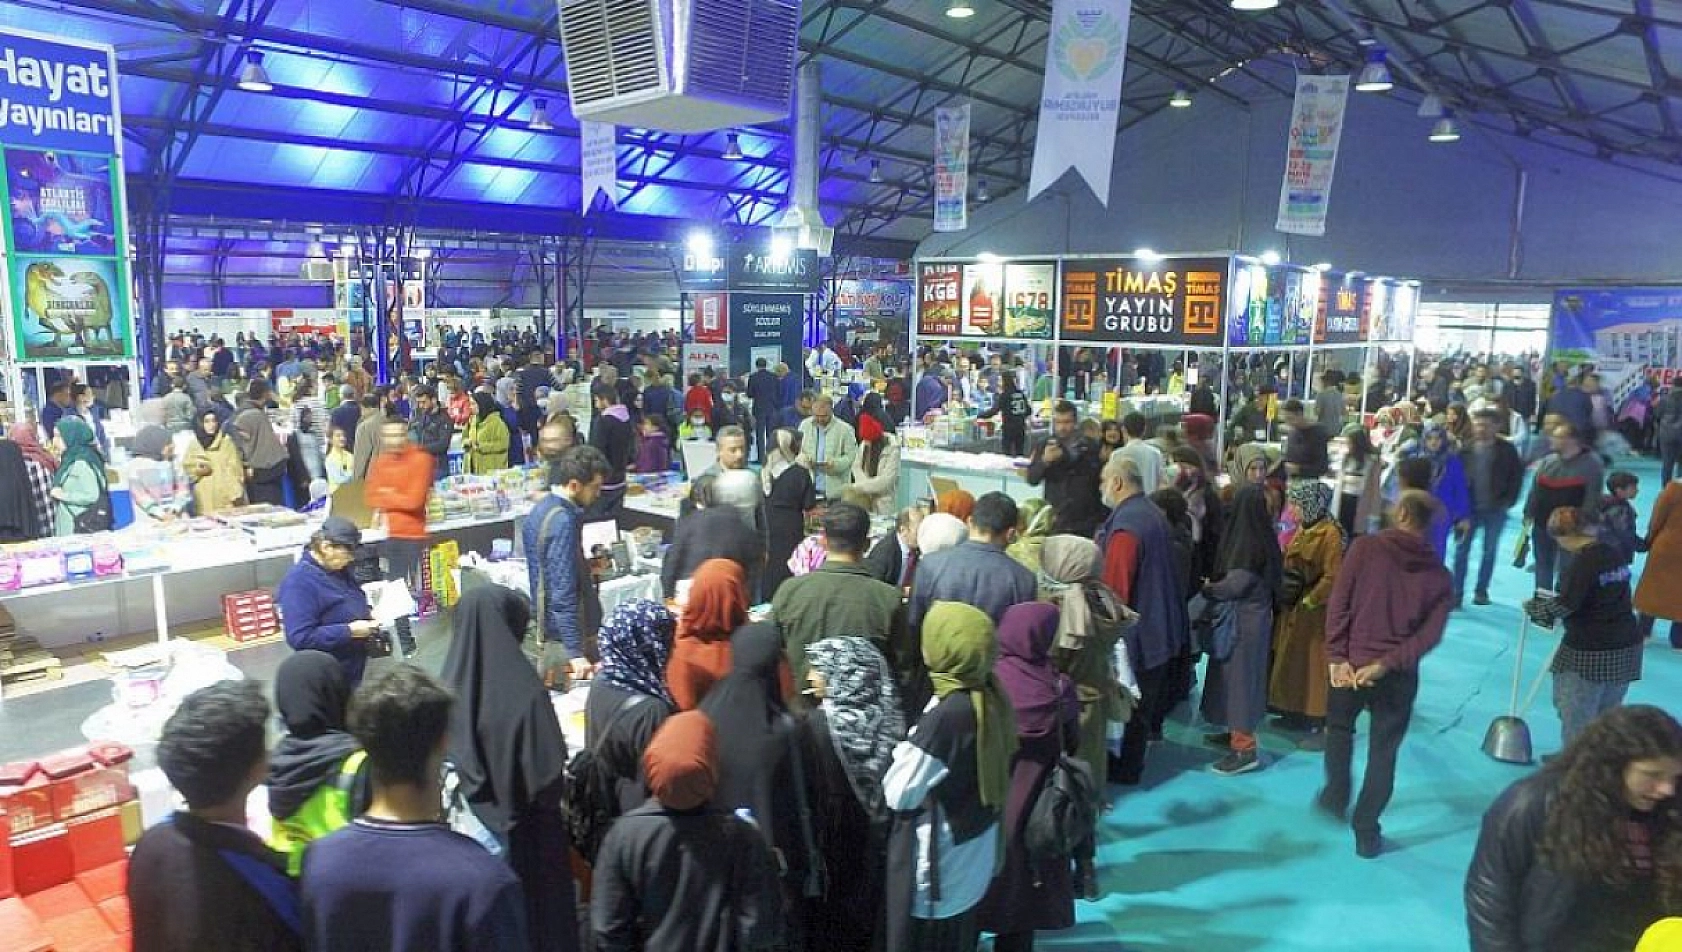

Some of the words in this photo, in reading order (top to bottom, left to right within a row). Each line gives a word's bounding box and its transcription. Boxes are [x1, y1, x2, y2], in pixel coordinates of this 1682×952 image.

[0, 48, 109, 101] Hayat
[923, 282, 957, 301] KGB
[1105, 267, 1177, 298] TİMAŞ
[1105, 296, 1174, 315] YAYIN
[1105, 315, 1174, 333] GRUBU
